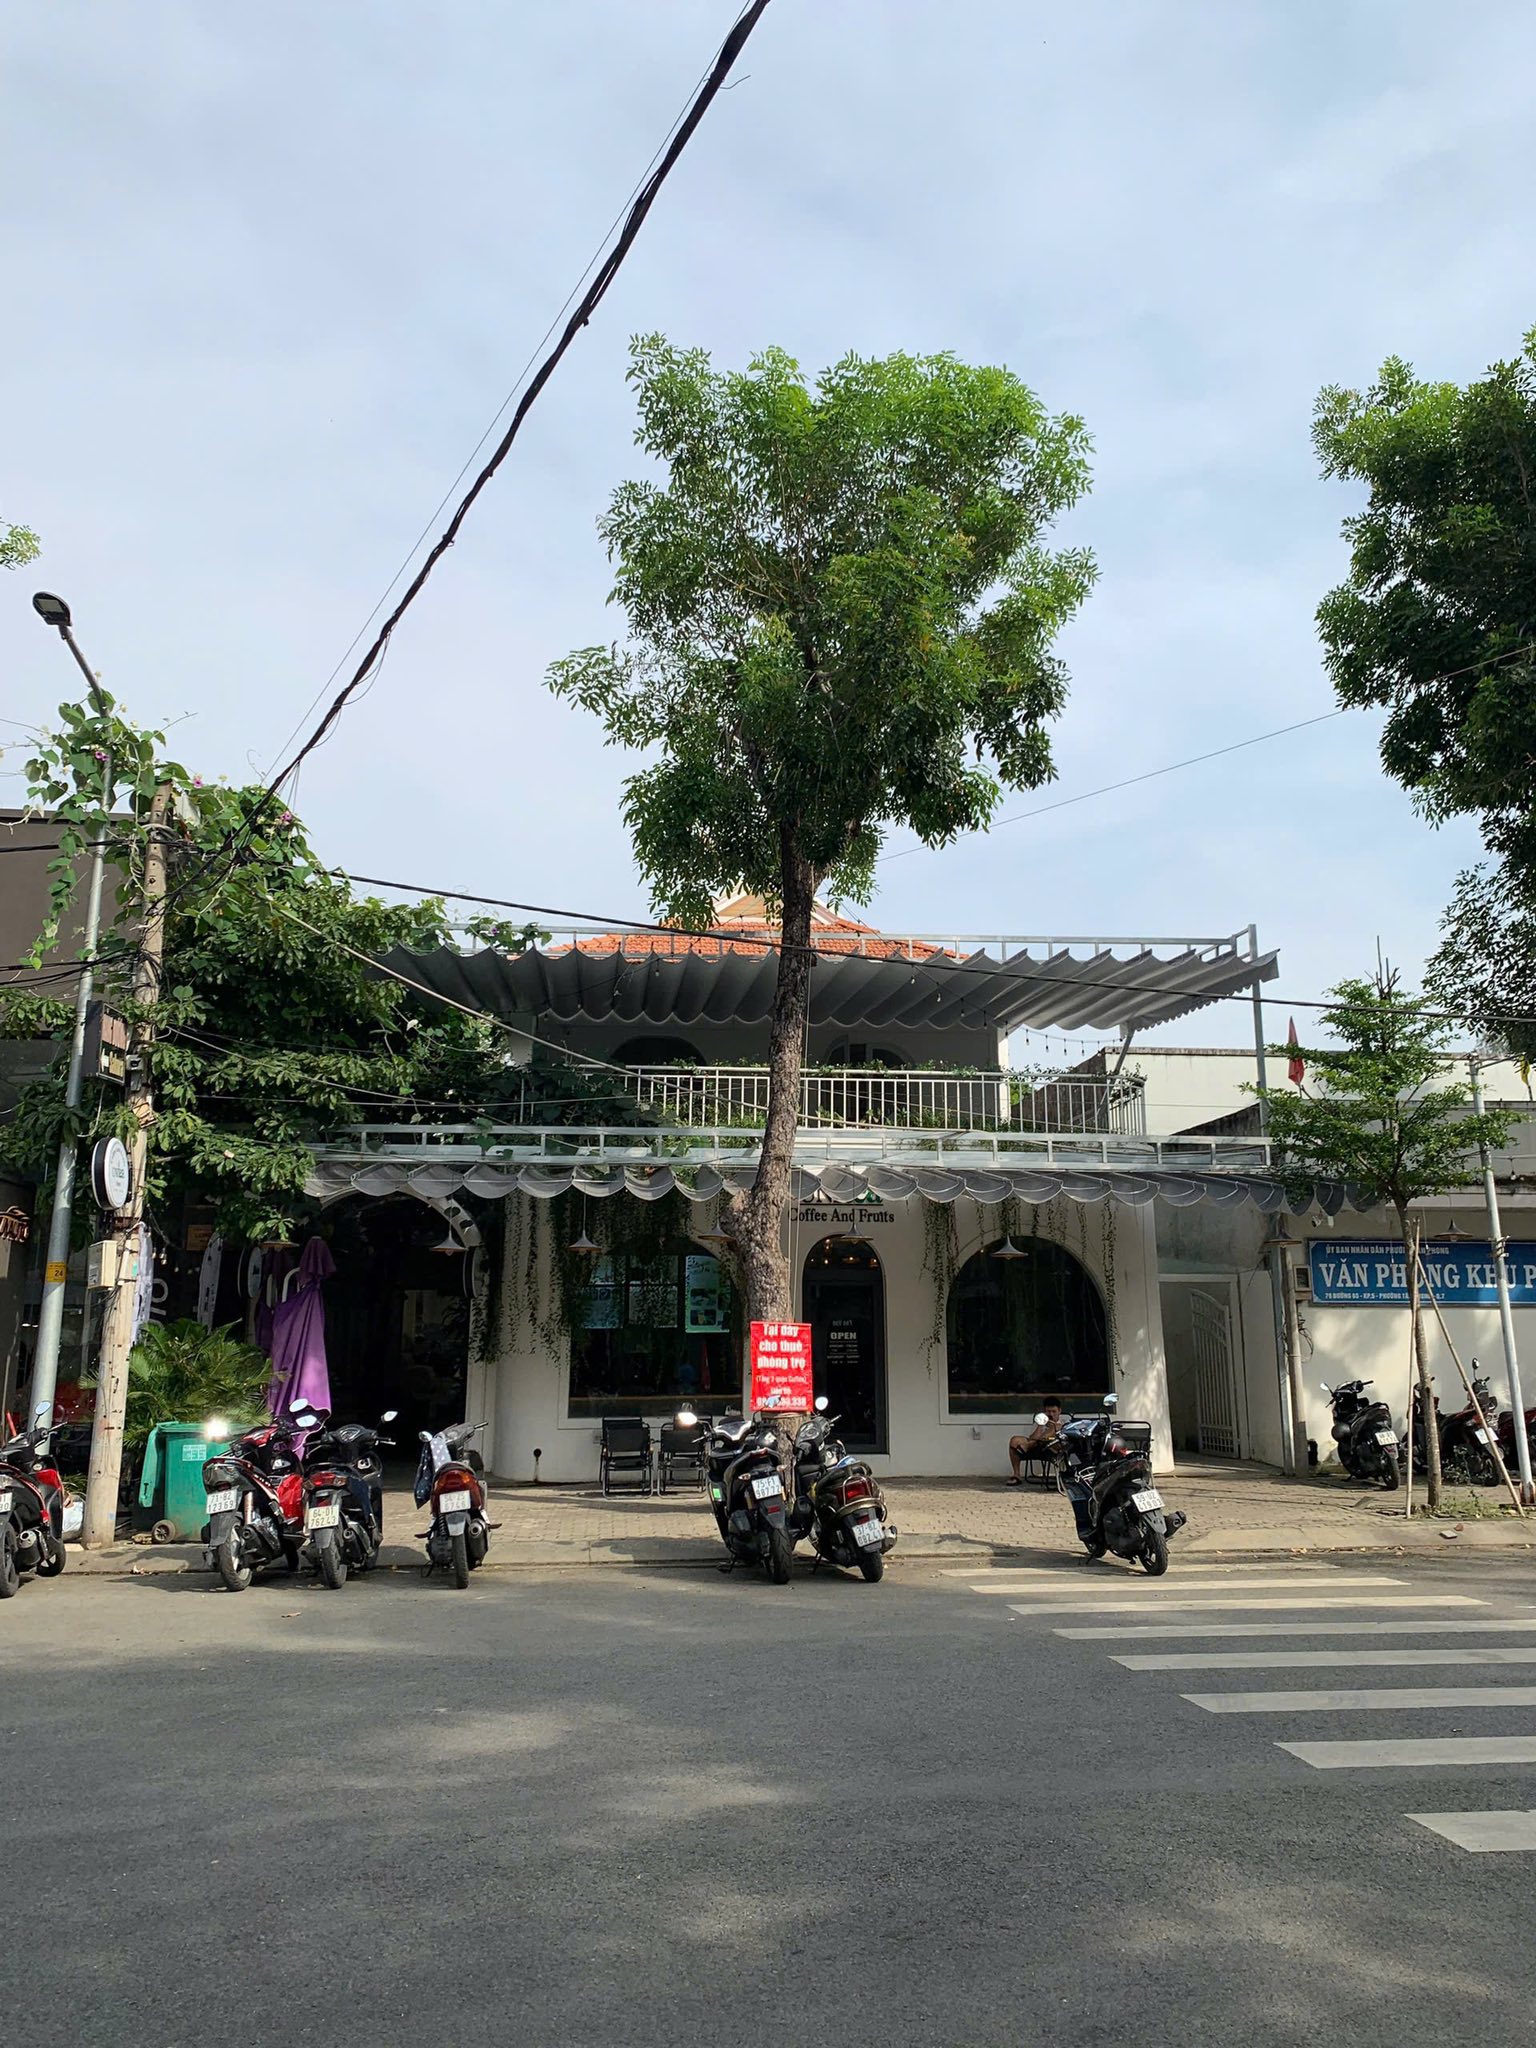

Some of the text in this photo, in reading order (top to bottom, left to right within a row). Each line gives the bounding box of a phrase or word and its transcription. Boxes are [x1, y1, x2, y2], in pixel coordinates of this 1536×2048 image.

[788, 1207, 895, 1223] Coffee And Fruits
[1319, 1258, 1369, 1288] VĂN
[830, 1332, 857, 1340] OPEN
[759, 1339, 778, 1352] cho
